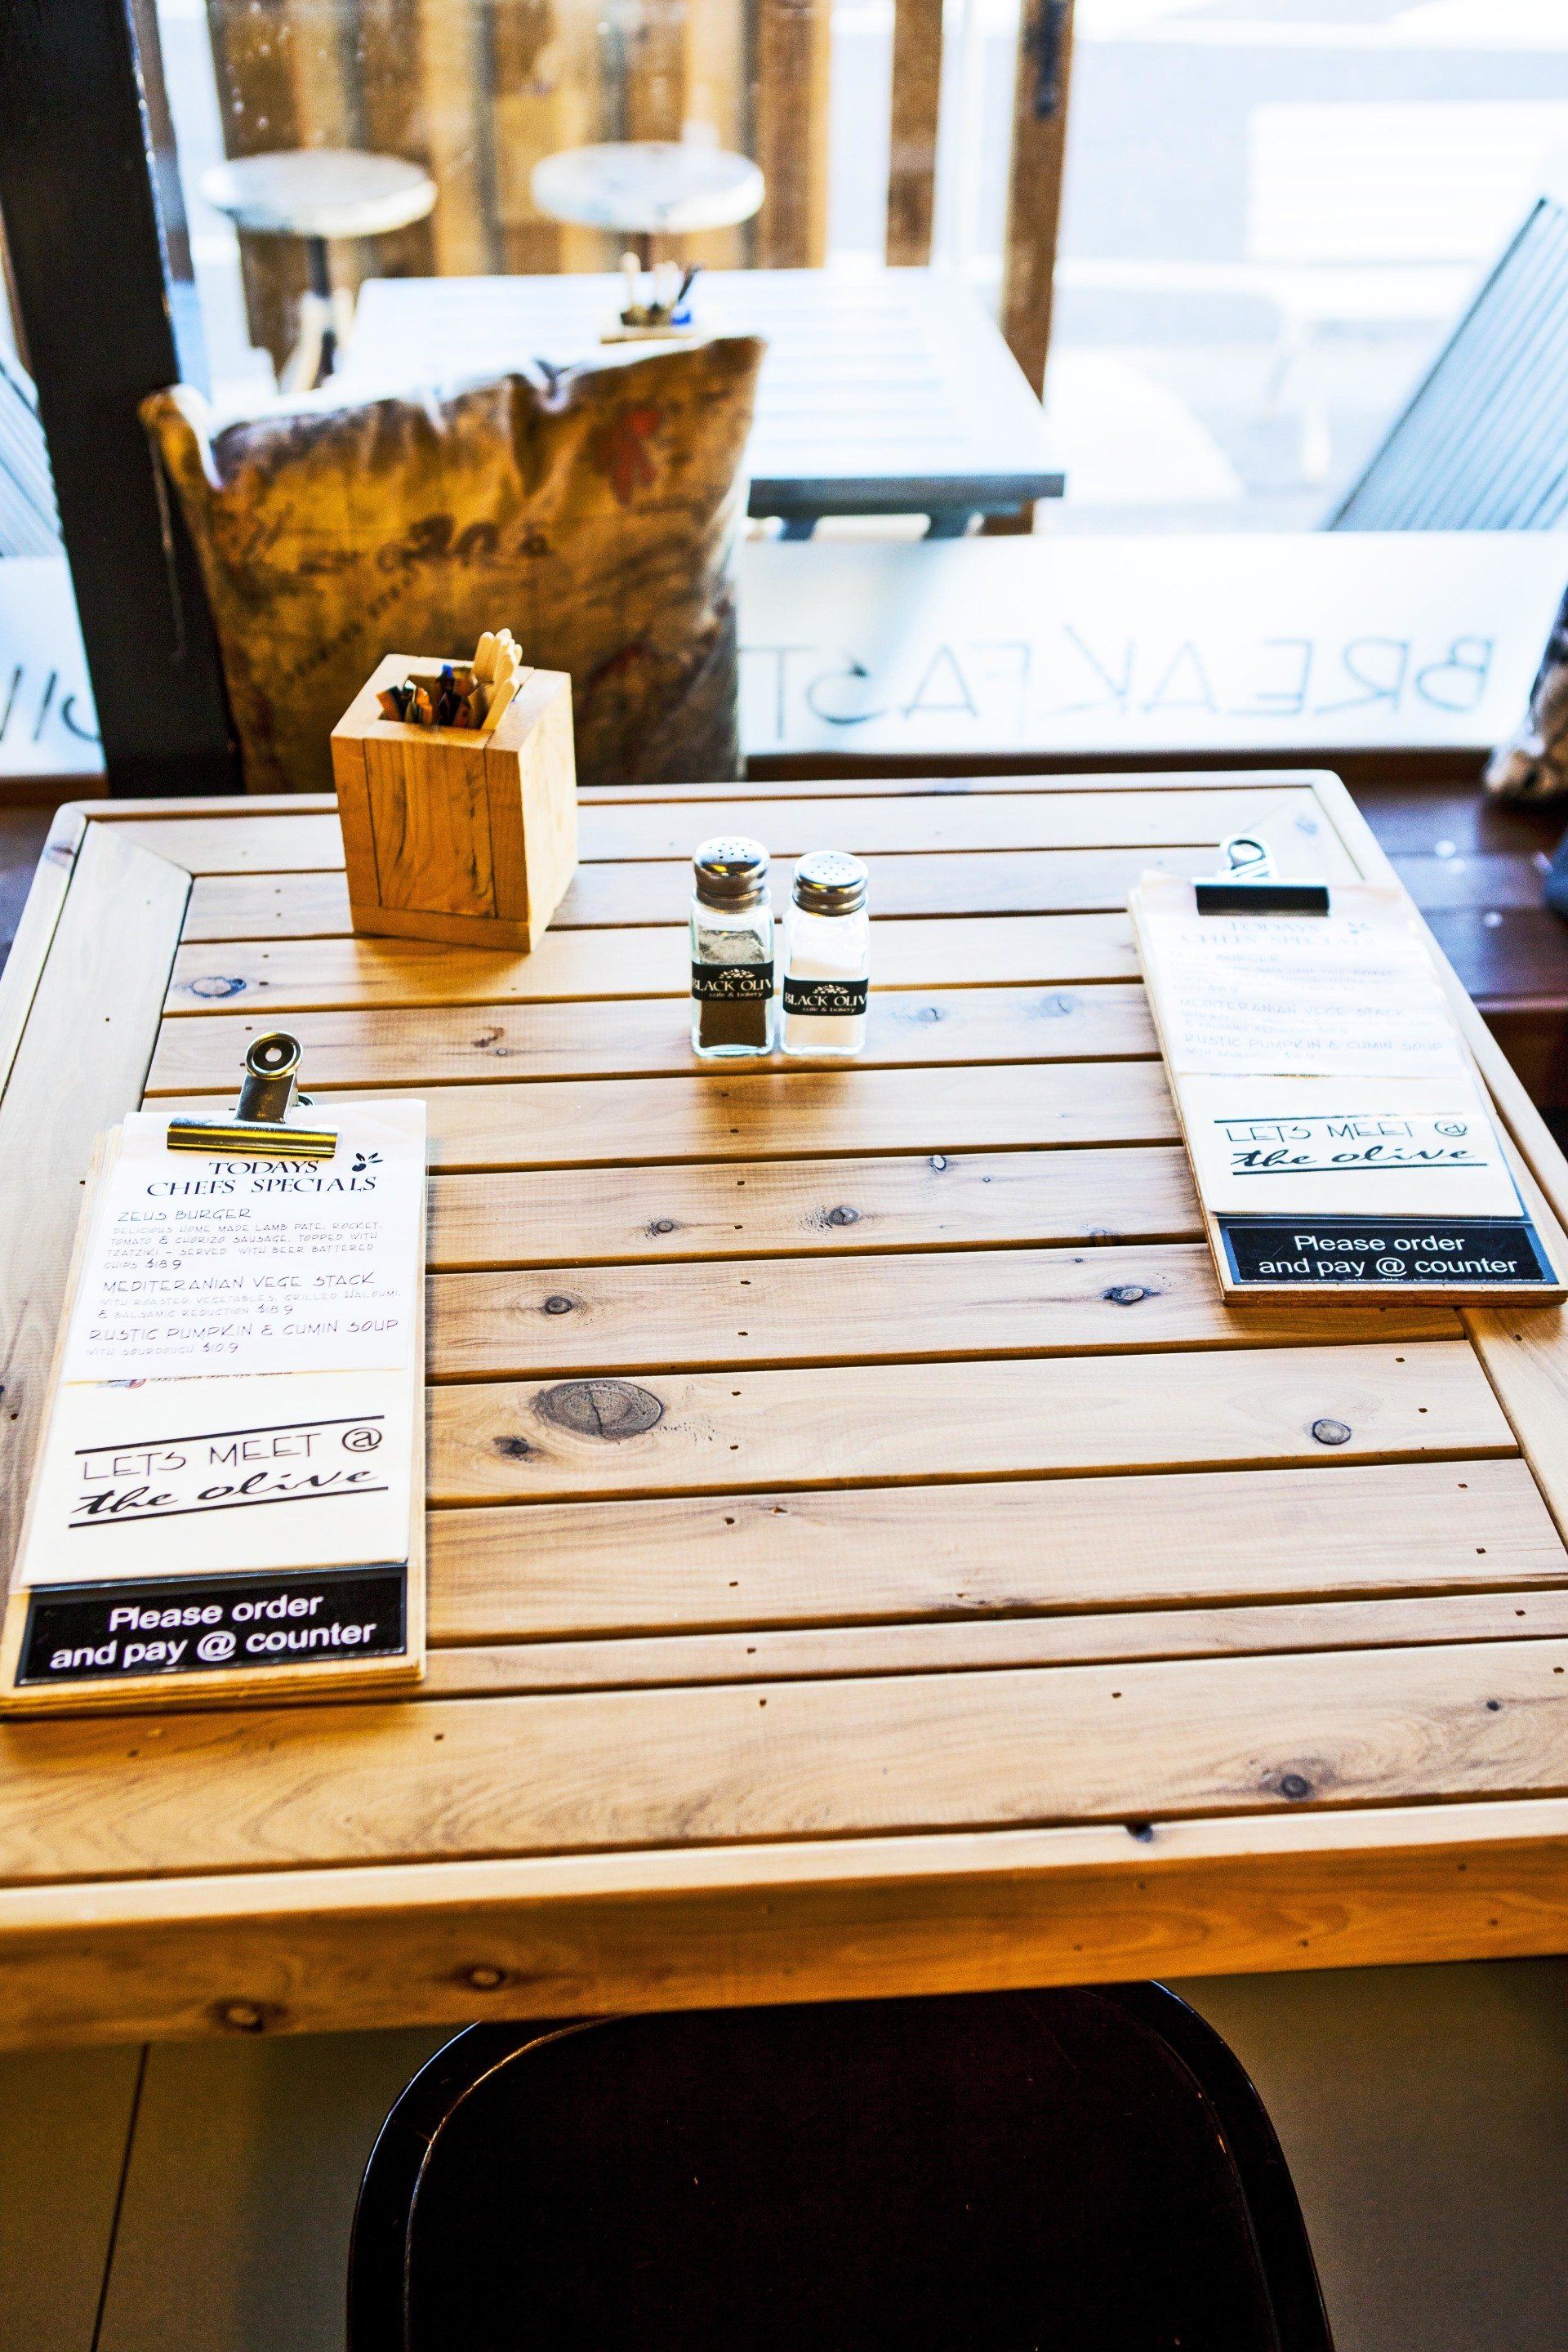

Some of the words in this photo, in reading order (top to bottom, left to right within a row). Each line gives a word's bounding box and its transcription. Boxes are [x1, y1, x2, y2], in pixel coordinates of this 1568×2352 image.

[1225, 1125, 1312, 1143] LETS
[1326, 1120, 1414, 1140] MEET
[1434, 1120, 1468, 1137] @
[1231, 1146, 1316, 1166] the
[1331, 1145, 1477, 1164] olive
[208, 1159, 320, 1175] TODAYS
[147, 1180, 236, 1196] CHEFS
[251, 1175, 377, 1194] SPECIALS
[118, 1210, 167, 1223] ZEUS
[176, 1208, 252, 1220] BURGER
[111, 1236, 152, 1247] TOMATO
[159, 1236, 168, 1245] &
[175, 1235, 225, 1245] CHORIZO
[298, 1232, 343, 1243] TOPPED
[350, 1230, 378, 1241] WITH
[180, 1225, 212, 1234] HOME
[218, 1223, 250, 1233] MADE
[256, 1222, 287, 1232] LAMB
[238, 1245, 266, 1257] WITH
[273, 1245, 305, 1254] BEER
[311, 1243, 374, 1254] BATTERED
[1294, 1235, 1386, 1251] Please
[1394, 1235, 1465, 1251] order
[1259, 1258, 1310, 1274] and
[1318, 1259, 1365, 1276] pay
[1375, 1257, 1407, 1277] @
[1414, 1257, 1517, 1274] counter
[103, 1275, 244, 1293] MEDITERANIAN
[252, 1275, 302, 1290] VEGE
[313, 1272, 376, 1288] STACK
[88, 1327, 160, 1343] RUSTIC
[166, 1322, 252, 1341] PUMPKIN
[261, 1323, 273, 1336] &
[283, 1320, 338, 1338] CUMIN
[346, 1318, 399, 1334] SOUP
[82, 1451, 187, 1480] LETS
[208, 1432, 324, 1467] MEET
[341, 1428, 383, 1453] @
[69, 1486, 179, 1516] the
[197, 1471, 378, 1499] olive
[108, 1604, 223, 1633] Please
[231, 1595, 324, 1621] order
[48, 1640, 117, 1670] and
[122, 1640, 189, 1669] pay
[196, 1631, 237, 1661] @
[245, 1621, 377, 1652] counter
